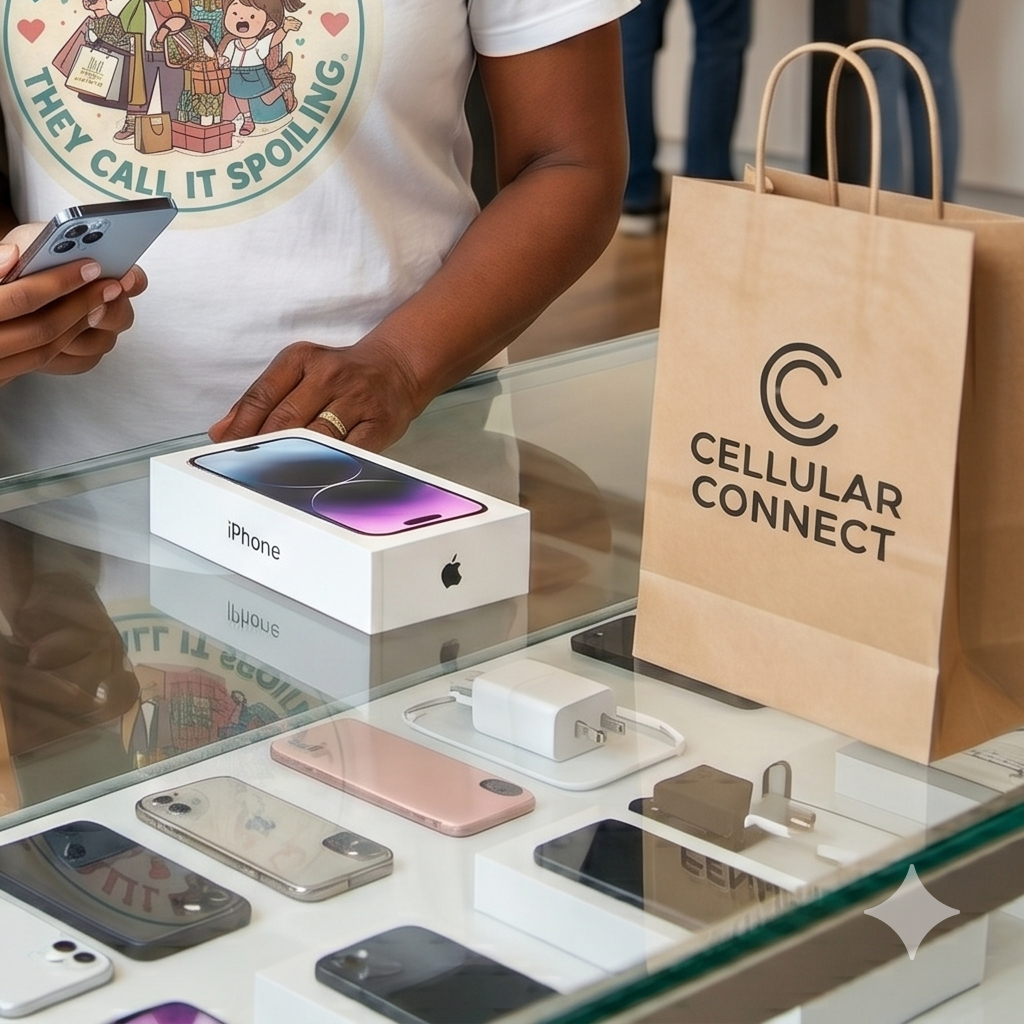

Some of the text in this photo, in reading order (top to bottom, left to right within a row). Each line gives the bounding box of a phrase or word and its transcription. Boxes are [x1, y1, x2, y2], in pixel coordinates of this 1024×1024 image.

[24, 60, 345, 198] THEY CALL IT SPOILING
[690, 431, 903, 520] CELLULAR
[691, 475, 896, 562] CONNECT
[227, 519, 281, 561] iPhone
